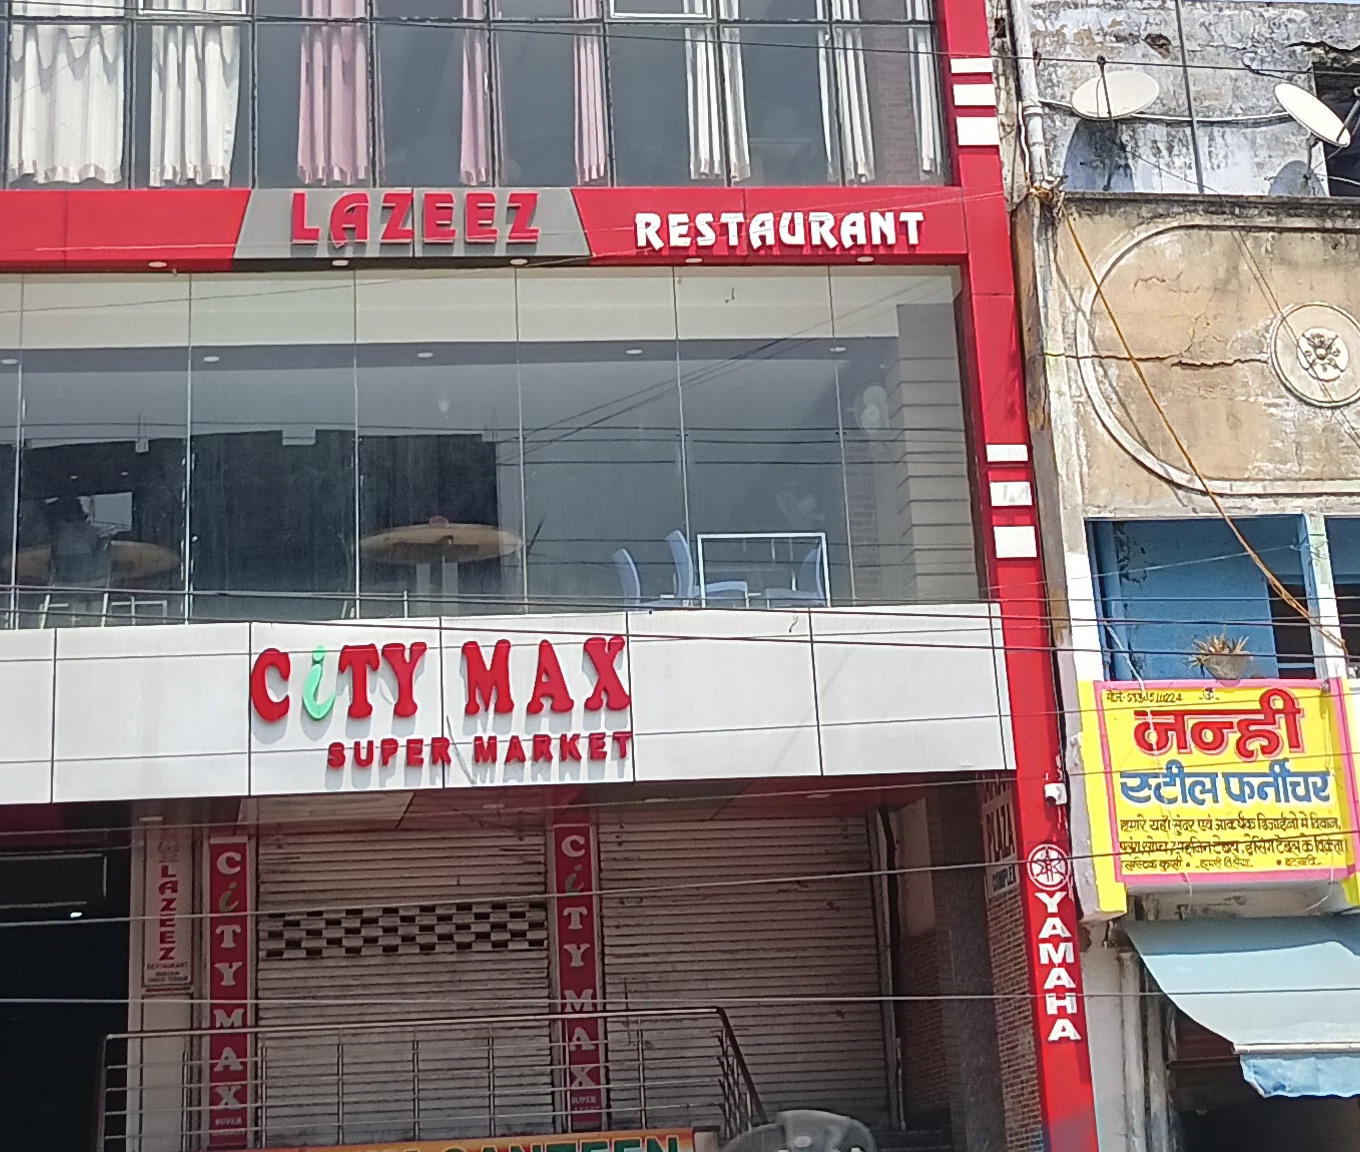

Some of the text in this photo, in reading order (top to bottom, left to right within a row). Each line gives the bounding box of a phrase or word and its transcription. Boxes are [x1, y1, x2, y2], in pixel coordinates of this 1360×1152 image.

[291, 192, 540, 248] LAZEEZ
[635, 211, 924, 249] RESTAURANT
[461, 636, 632, 715] MAX
[327, 732, 632, 769] SUPER MARKET
[1120, 759, 1220, 805] स्टील
[1197, 814, 1213, 831] एवं
[158, 865, 178, 961] LAZEEZ
[1034, 891, 1082, 1042] YAMAHA
[213, 1008, 245, 1110] MAX
[563, 988, 597, 1090] MAX
